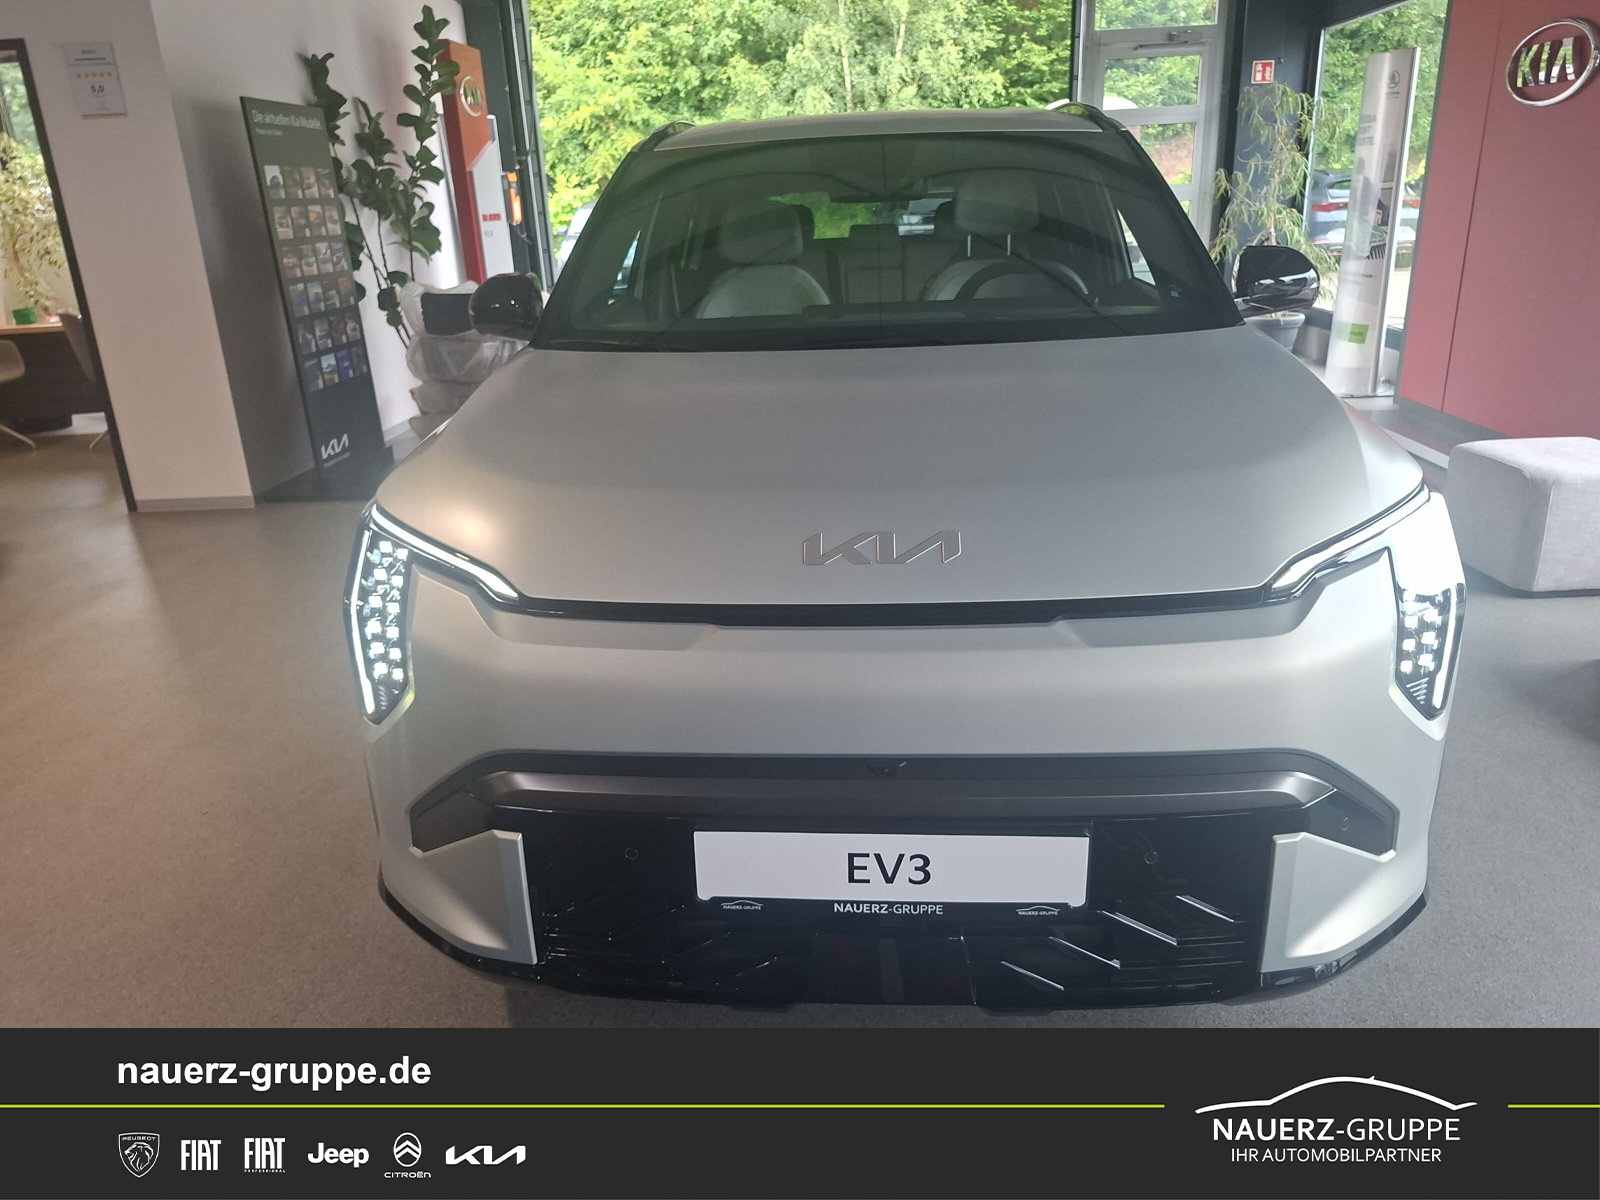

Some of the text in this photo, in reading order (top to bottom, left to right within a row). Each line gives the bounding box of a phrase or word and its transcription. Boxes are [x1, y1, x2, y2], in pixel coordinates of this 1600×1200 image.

[1516, 37, 1576, 88] KIA
[803, 531, 962, 566] KIA
[847, 852, 931, 885] EV3
[833, 902, 944, 915] NAUERZ-GRUPPE
